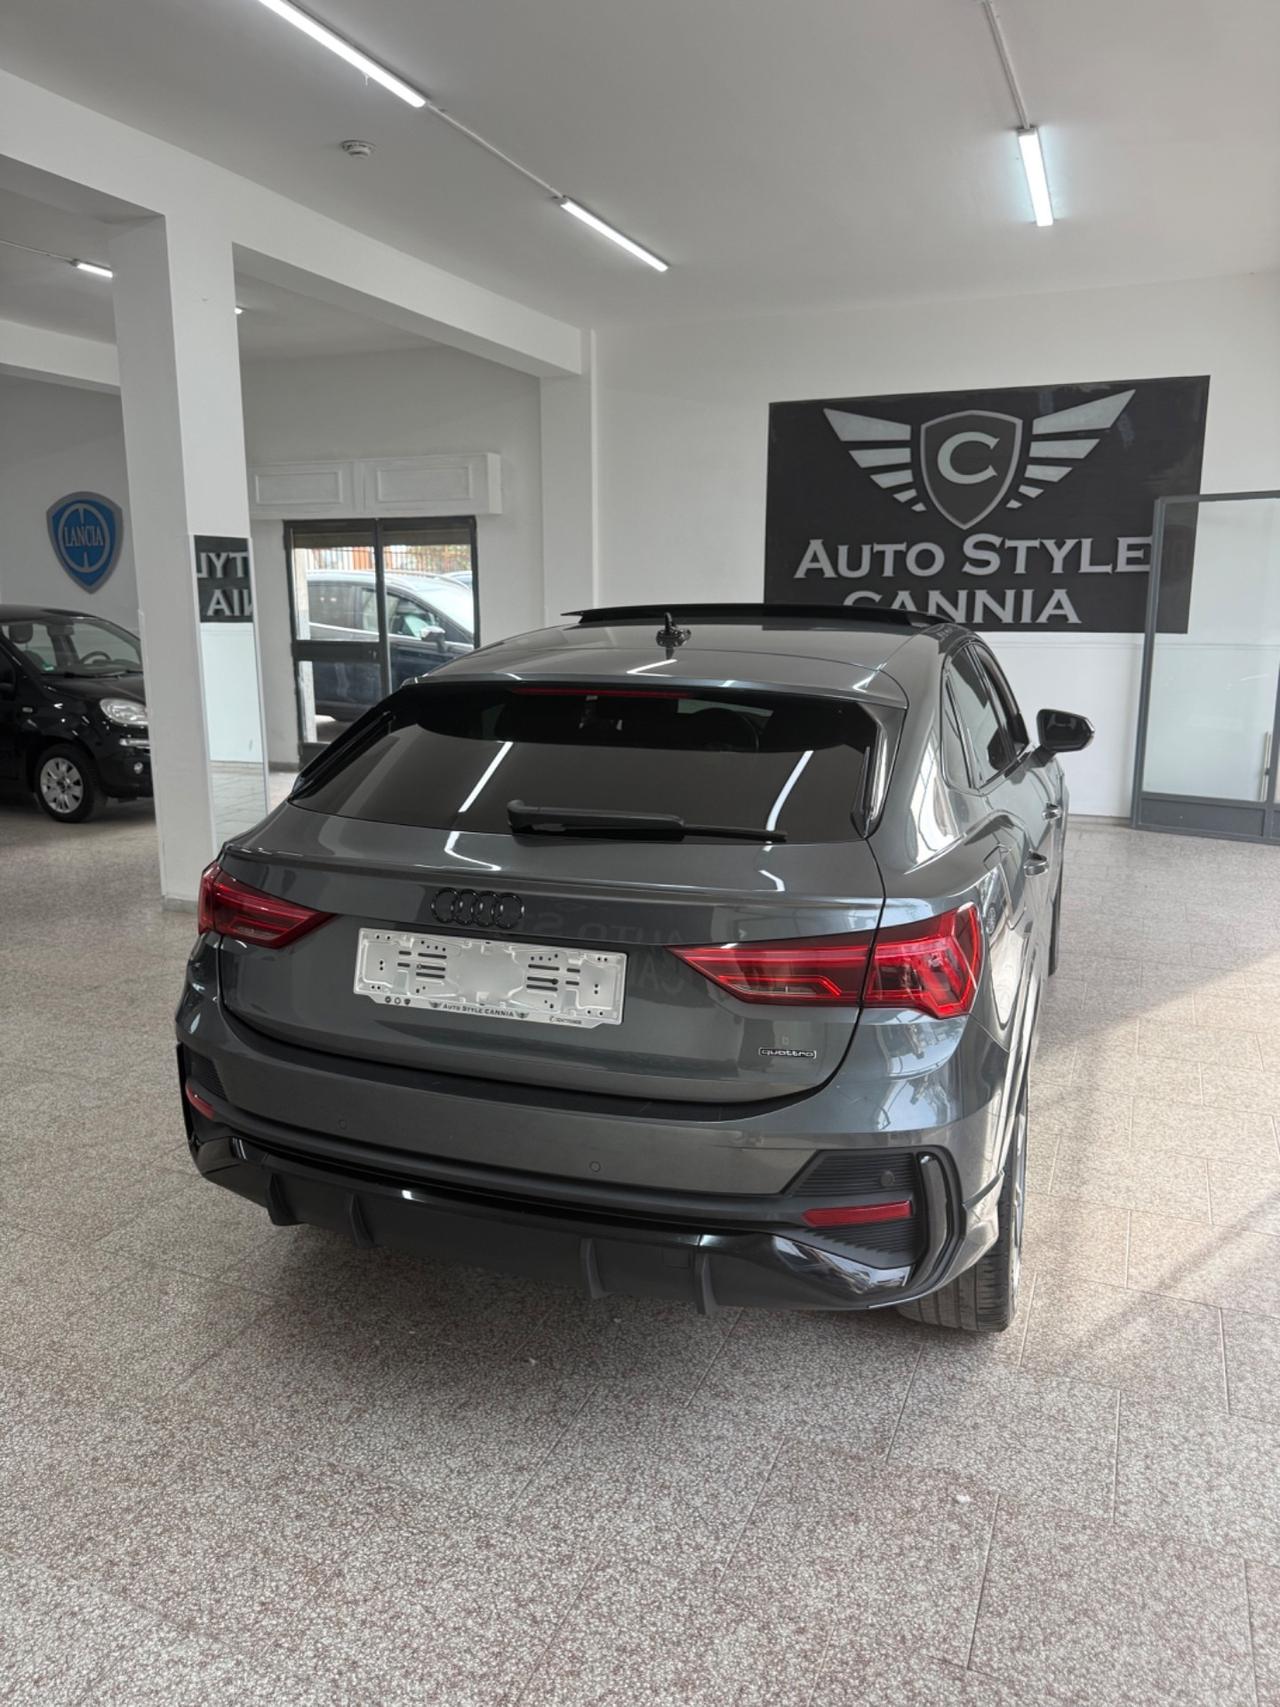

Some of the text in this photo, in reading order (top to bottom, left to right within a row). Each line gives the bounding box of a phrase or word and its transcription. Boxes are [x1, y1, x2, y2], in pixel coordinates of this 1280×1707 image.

[937, 431, 1000, 485] C
[64, 525, 104, 547] LANCIA
[793, 532, 1153, 579] AUTO STYLE
[484, 1007, 515, 1018] CANNIA
[760, 1048, 814, 1058] quattro
